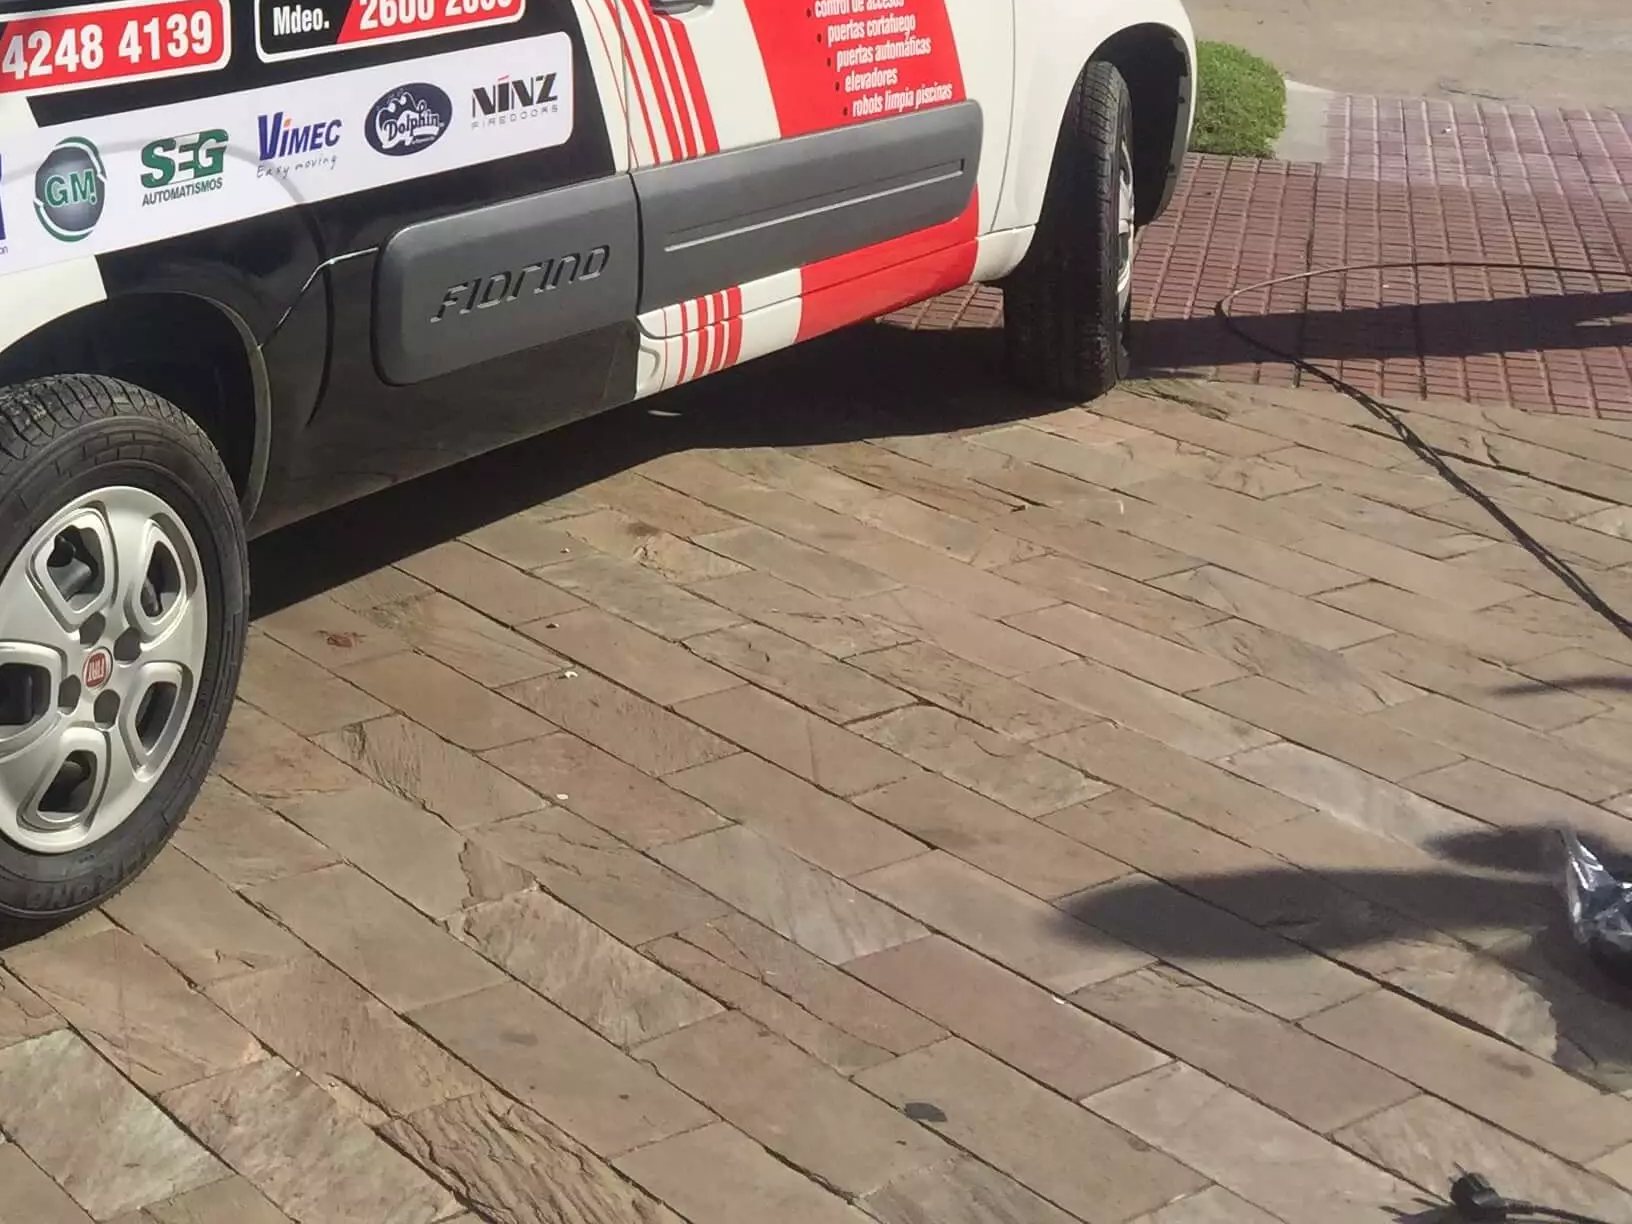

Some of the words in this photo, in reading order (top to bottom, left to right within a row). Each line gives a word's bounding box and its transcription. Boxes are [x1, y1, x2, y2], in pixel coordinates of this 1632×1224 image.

[272, 4, 330, 36] Mdeo.
[827, 16, 865, 47] puertas
[867, 13, 916, 41] cortafuego
[1, 23, 104, 80] 4248
[118, 10, 213, 64] 4139
[836, 43, 874, 70] puertas
[874, 36, 932, 62] automáticas
[844, 67, 898, 93] elevadores
[471, 104, 559, 130] FIREDOORS
[852, 93, 884, 118] robots
[884, 87, 915, 113] limpia
[915, 82, 953, 109] piscinas
[382, 107, 441, 142] Dolphin
[140, 128, 229, 189] SEG
[256, 163, 290, 180] Easy
[294, 155, 338, 172] moving
[141, 177, 224, 207] AUTOMATISMOS
